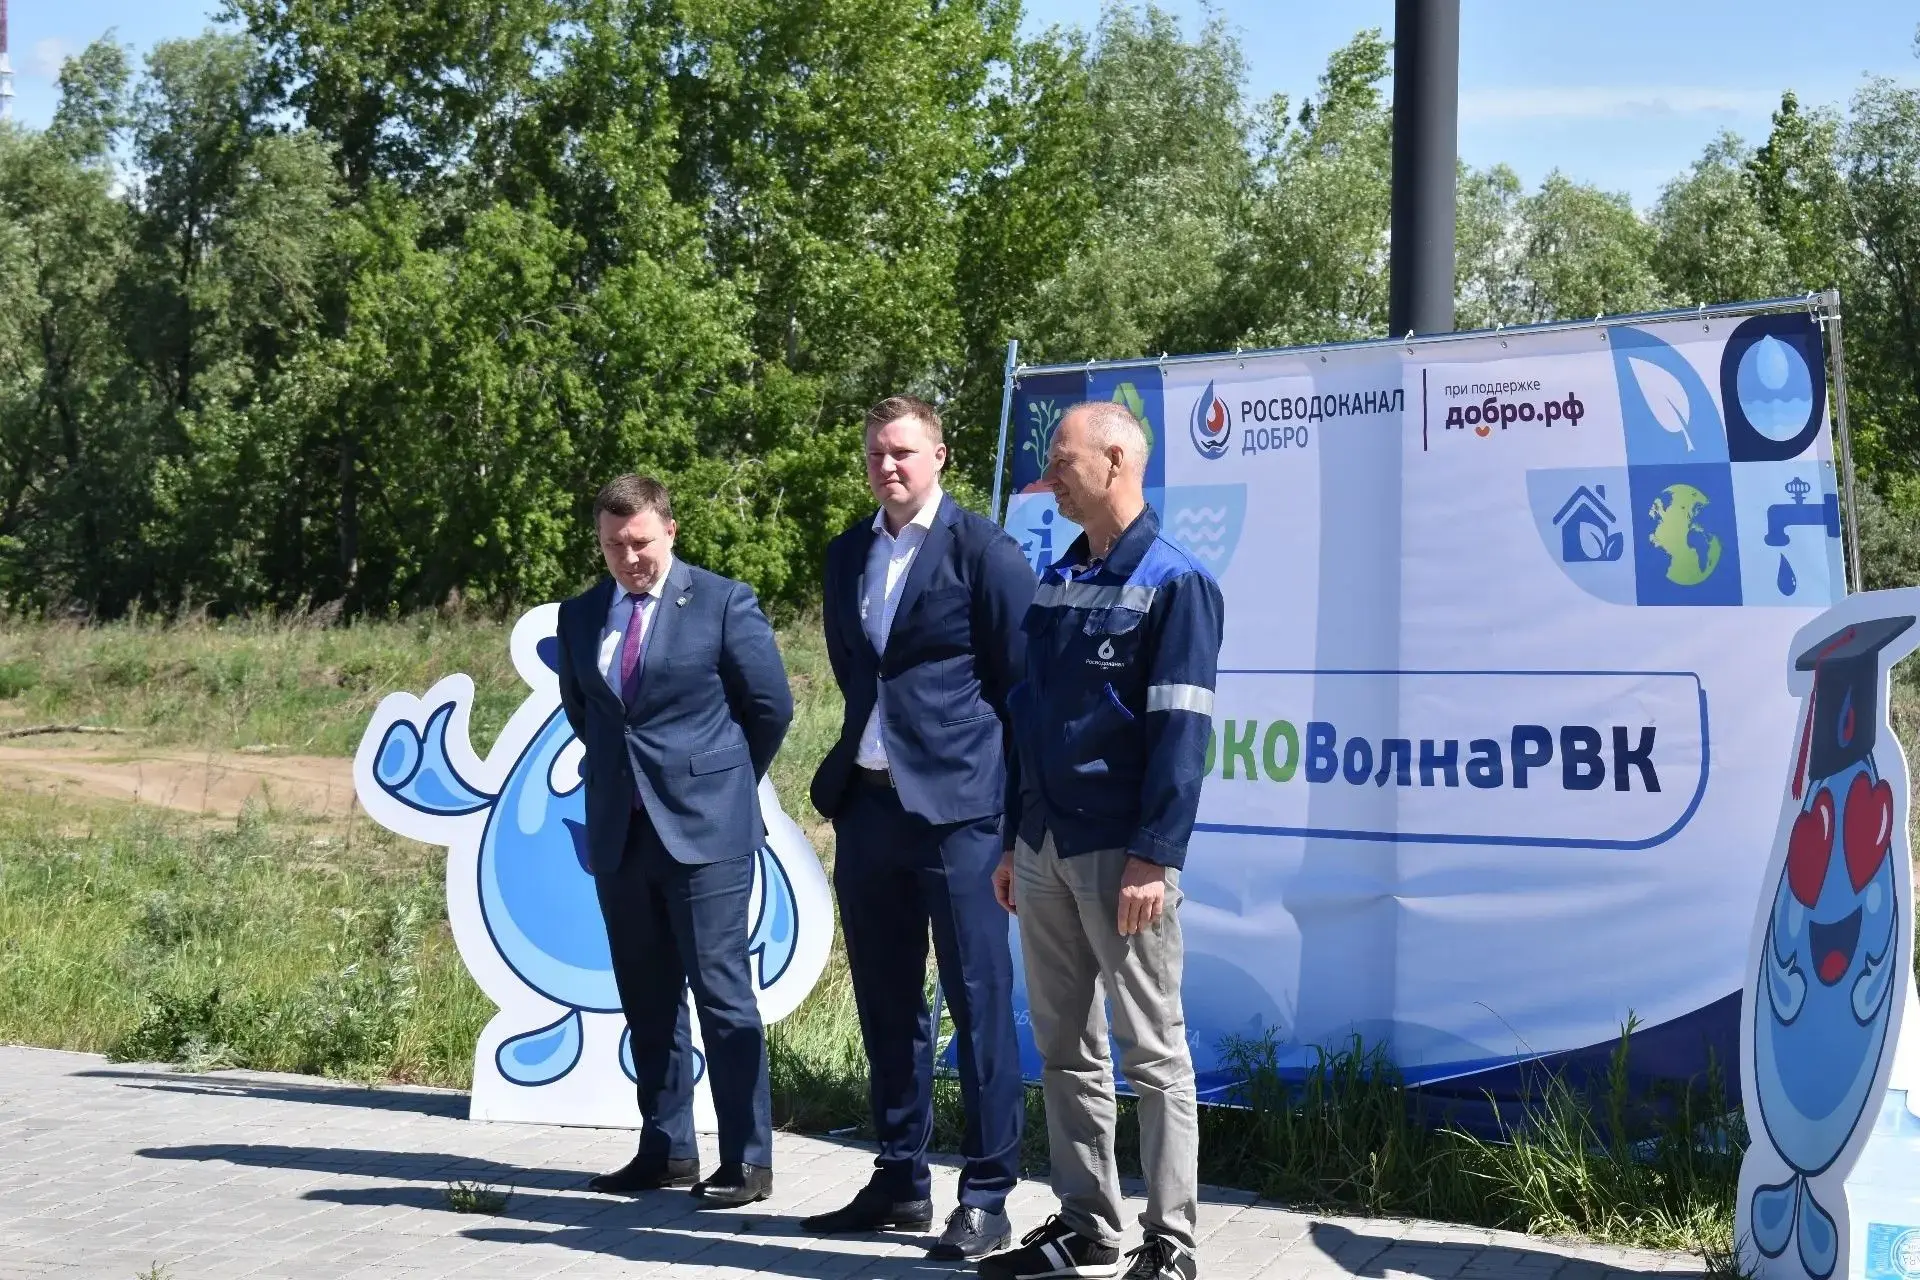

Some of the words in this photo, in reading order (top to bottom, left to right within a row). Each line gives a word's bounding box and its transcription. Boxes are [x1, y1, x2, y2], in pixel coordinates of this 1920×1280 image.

[1445, 384, 1468, 398] при
[1471, 380, 1541, 395] поддержке
[1241, 389, 1404, 423] РОСВОДОКАНАЛ
[1445, 392, 1585, 430] добро.рф
[1241, 425, 1308, 456] ДОБРО
